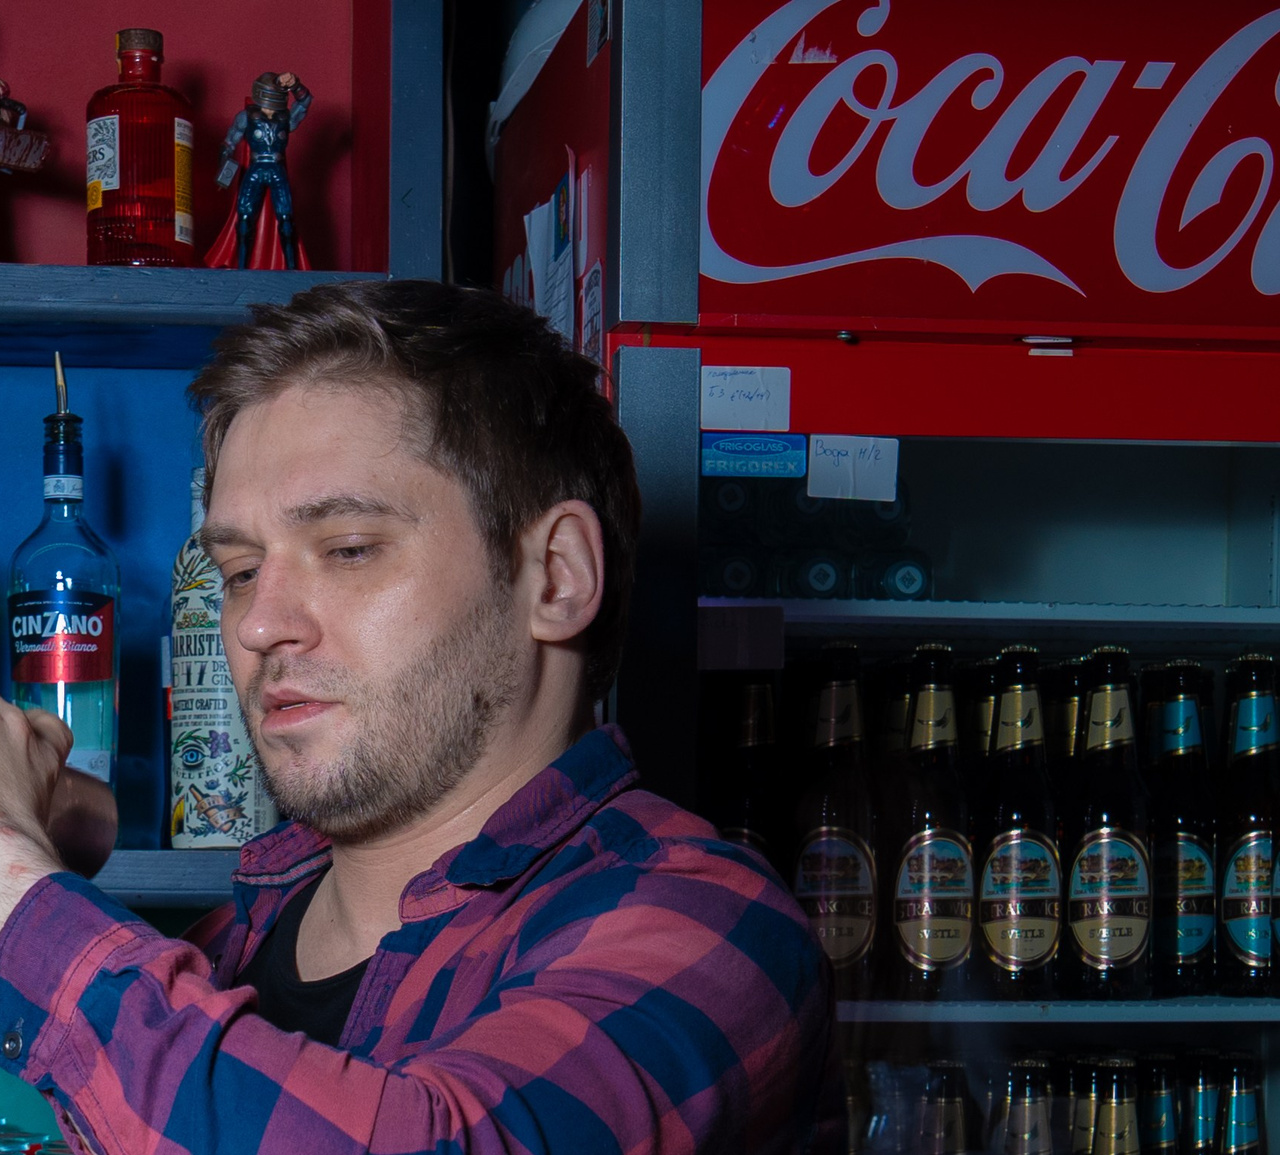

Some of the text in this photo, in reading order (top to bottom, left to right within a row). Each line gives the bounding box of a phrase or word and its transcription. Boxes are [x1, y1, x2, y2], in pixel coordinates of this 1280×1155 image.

[700, 0, 1280, 296] Coca-C
[719, 442, 784, 451] FRIGOGLASS
[815, 439, 850, 467] Вода
[705, 459, 798, 474] FRIGOREX
[12, 610, 103, 638] CINZANO
[15, 641, 57, 653] Vermouth
[212, 661, 231, 672] DR
[212, 674, 234, 686] GIN
[195, 698, 228, 711] CRAFTED
